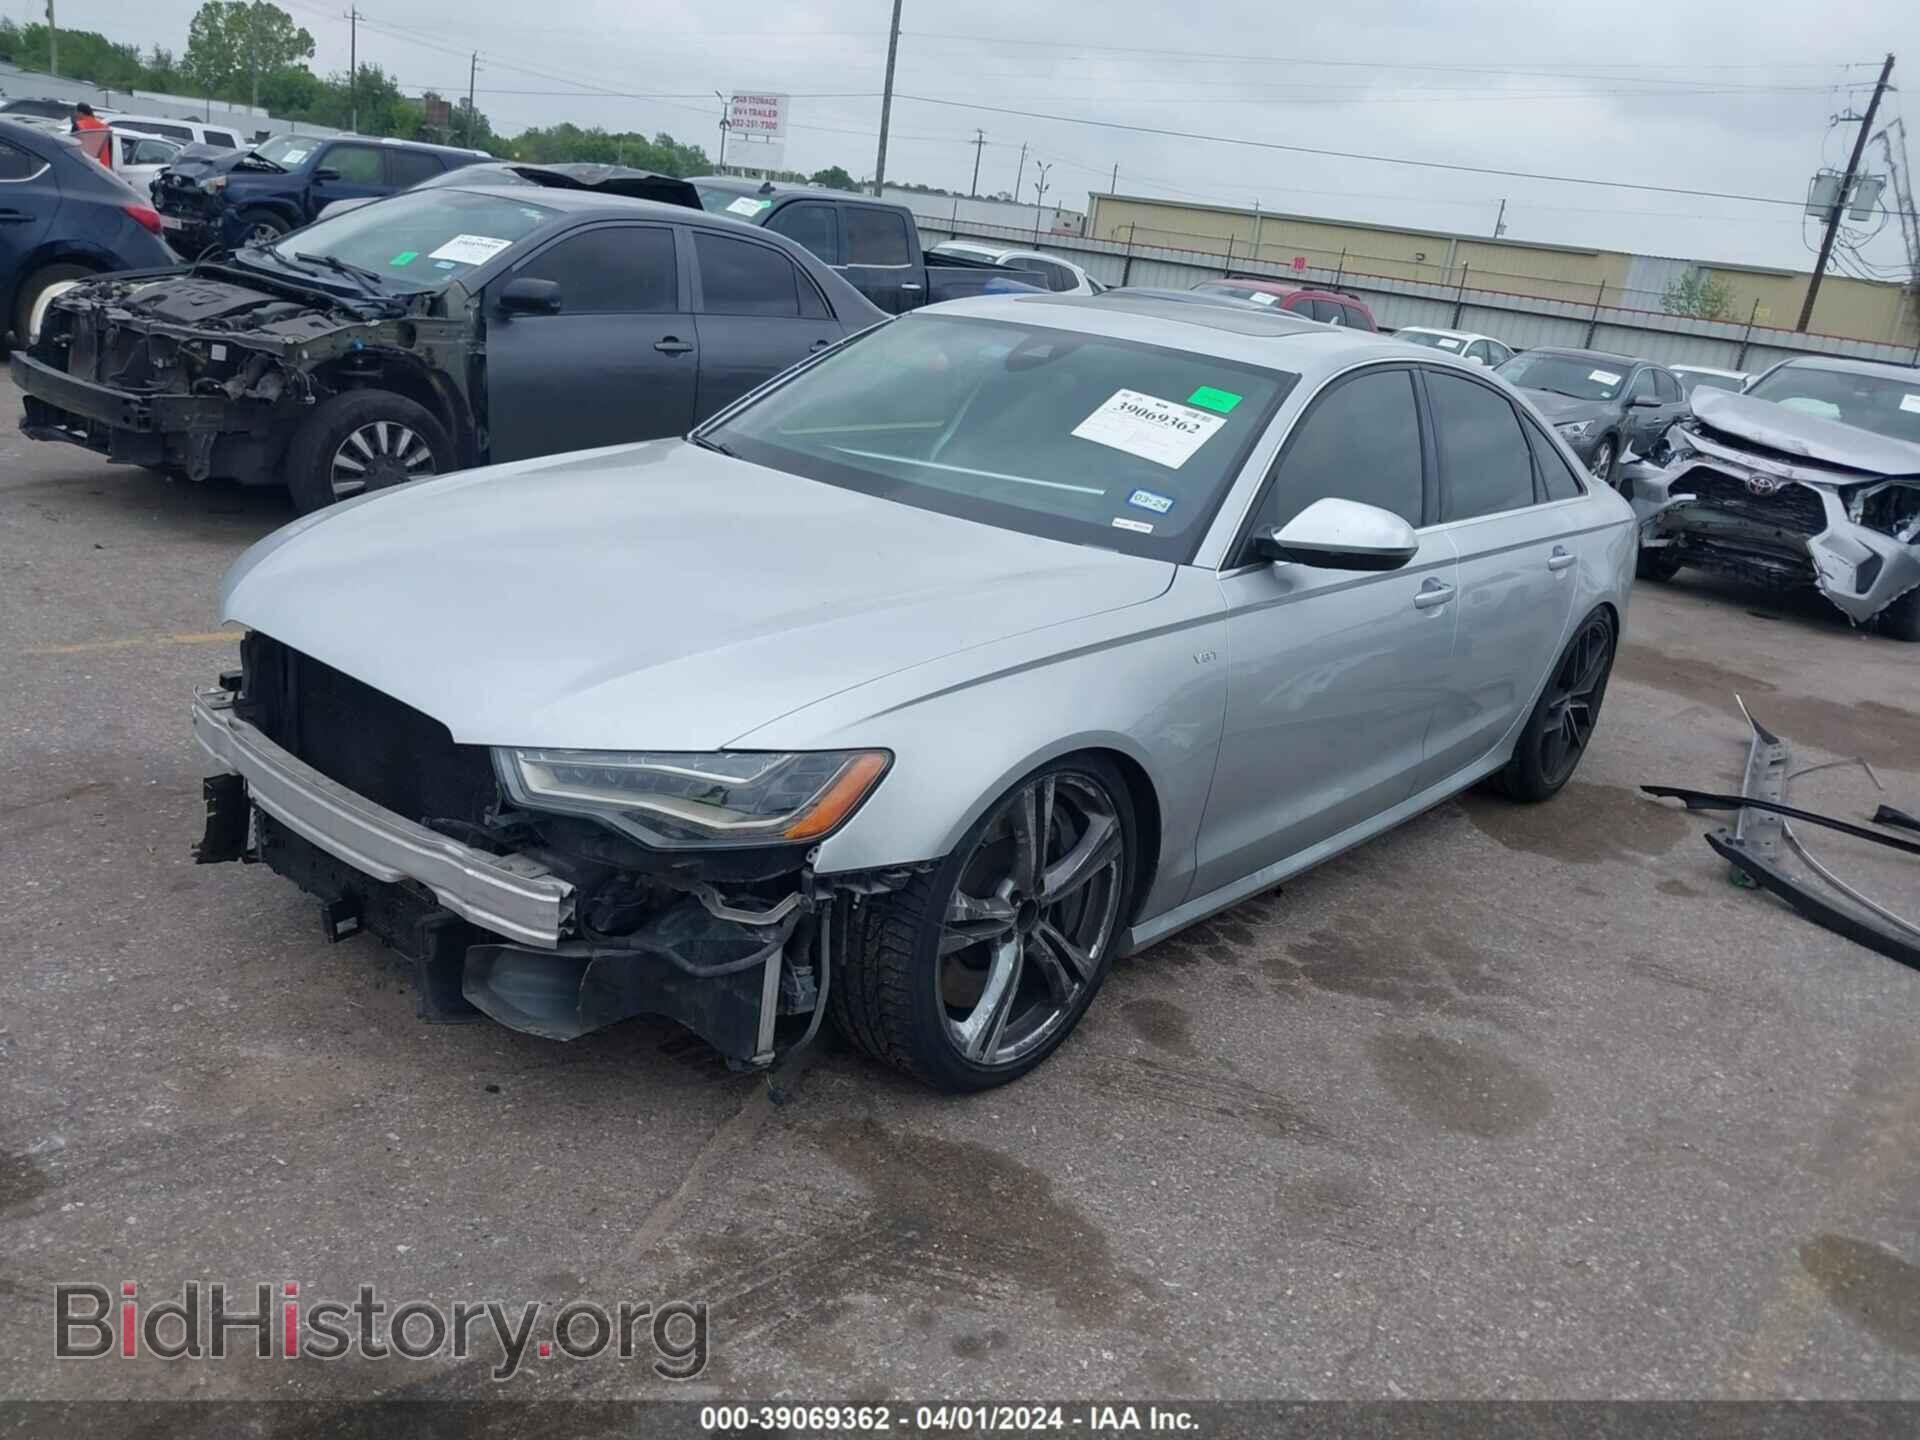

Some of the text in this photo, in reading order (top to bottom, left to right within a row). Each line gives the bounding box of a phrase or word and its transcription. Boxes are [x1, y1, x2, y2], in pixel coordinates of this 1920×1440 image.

[748, 96, 777, 106] STORAGE
[749, 108, 778, 118] TRAILER
[1113, 402, 1201, 434] 39069362
